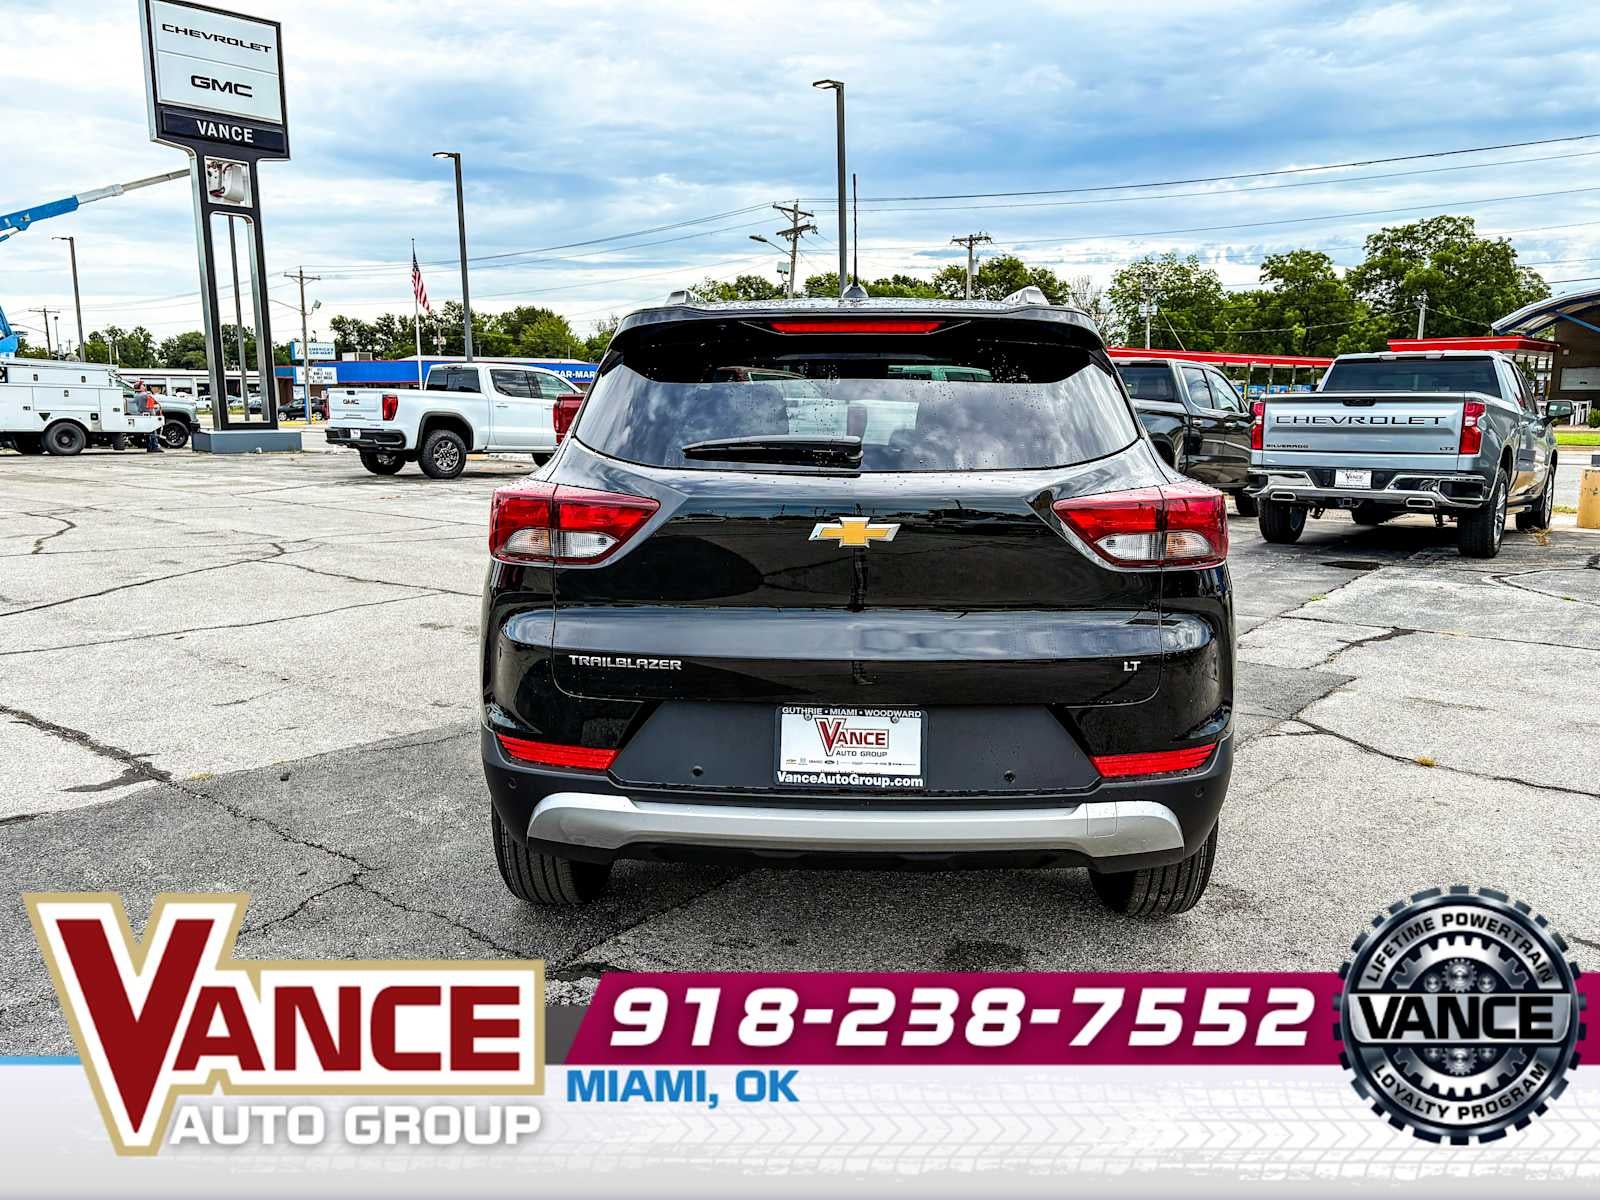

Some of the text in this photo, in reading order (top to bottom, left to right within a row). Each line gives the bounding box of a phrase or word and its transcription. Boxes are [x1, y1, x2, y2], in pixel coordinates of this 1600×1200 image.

[162, 23, 272, 54] CHEVROLET
[190, 75, 253, 98] GMC
[196, 120, 254, 143] VANCE
[1276, 415, 1447, 425] CHEVROLET
[568, 654, 682, 670] TRAILBLAZER
[1123, 660, 1142, 672] LT
[781, 706, 922, 719] GUTHRIE MIAMI WOODWARD
[817, 719, 887, 754] VANCE
[860, 750, 888, 758] GROUP
[777, 770, 924, 788] VanceAutoGroup.com
